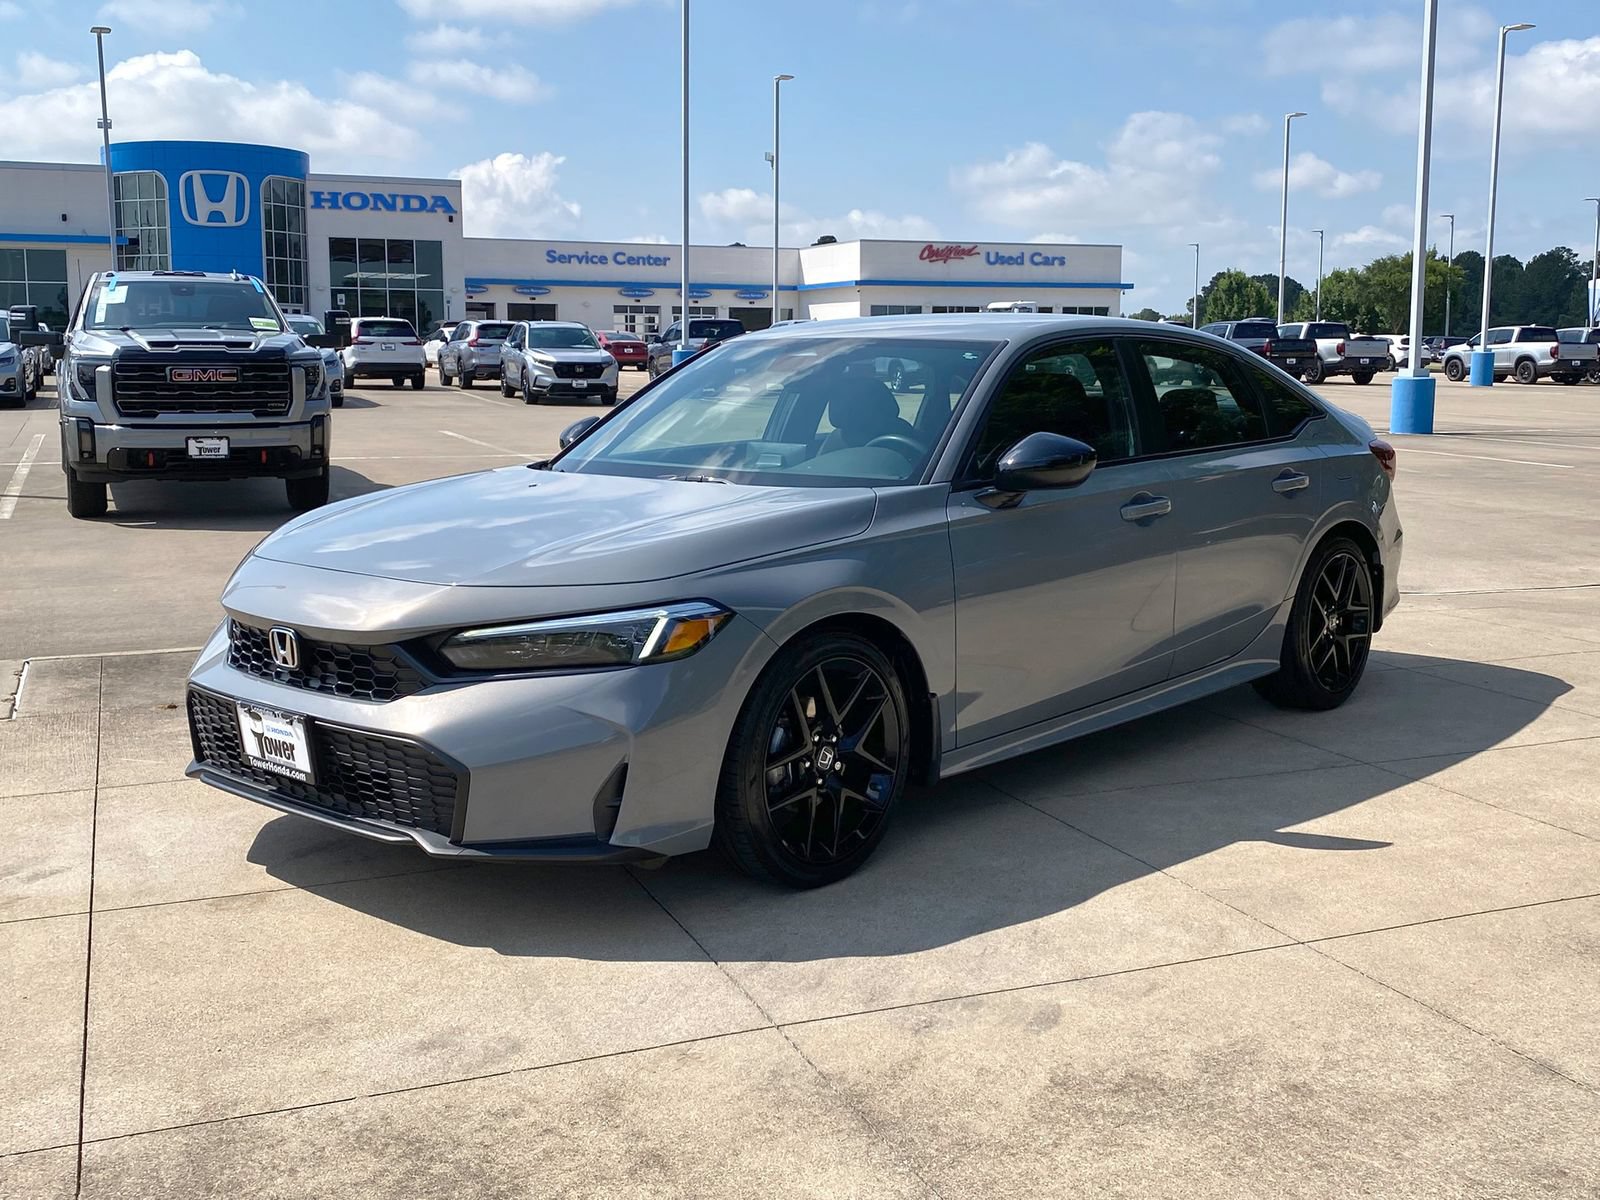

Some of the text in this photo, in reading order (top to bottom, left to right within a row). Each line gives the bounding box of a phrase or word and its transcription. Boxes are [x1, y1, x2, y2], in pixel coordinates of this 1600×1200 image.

[310, 191, 458, 214] HONDA
[545, 249, 671, 266] Service Center
[919, 244, 1066, 266] Certified Used Cars
[172, 369, 238, 381] GMC
[271, 727, 294, 738] HONDA
[248, 755, 307, 782] TowerHonda.com
